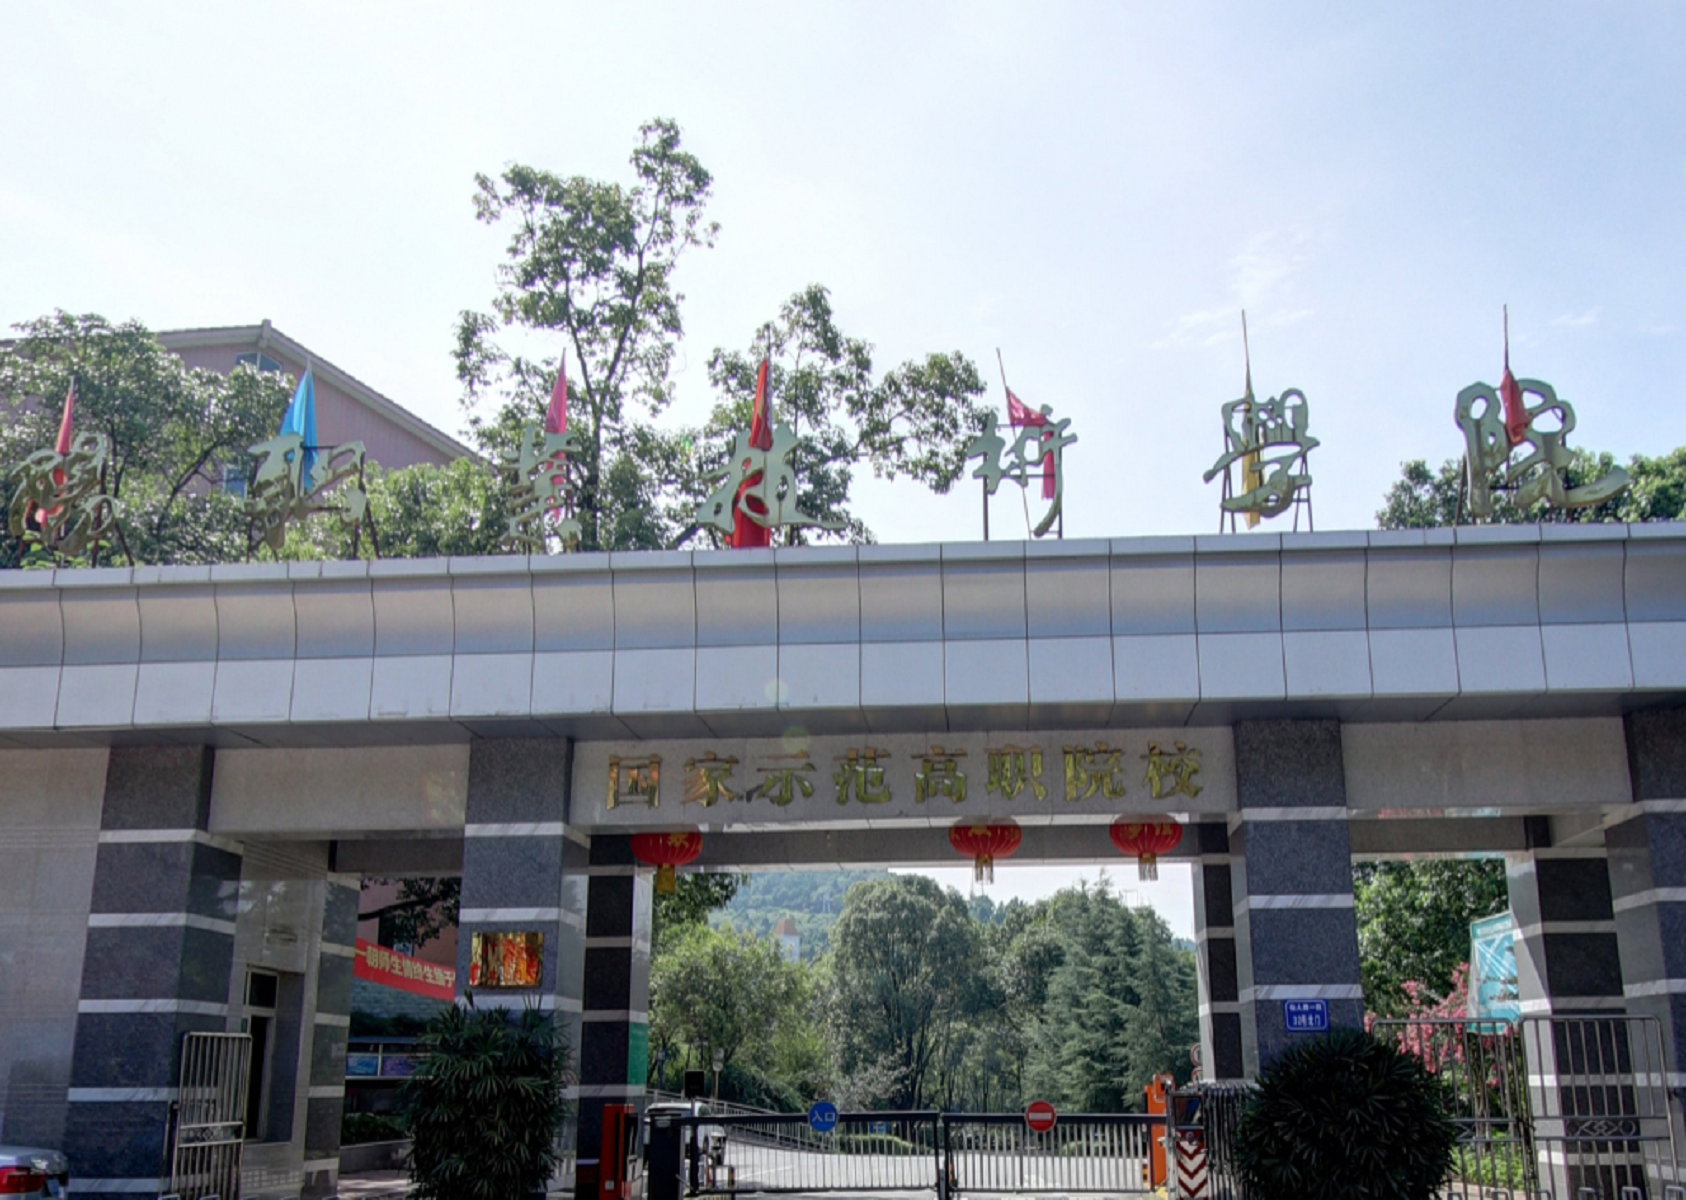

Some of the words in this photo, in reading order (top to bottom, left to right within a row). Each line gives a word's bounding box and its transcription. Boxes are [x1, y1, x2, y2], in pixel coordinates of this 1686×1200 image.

[605, 741, 1204, 810] 国家示范高职院校
[811, 1110, 836, 1122] 入口
